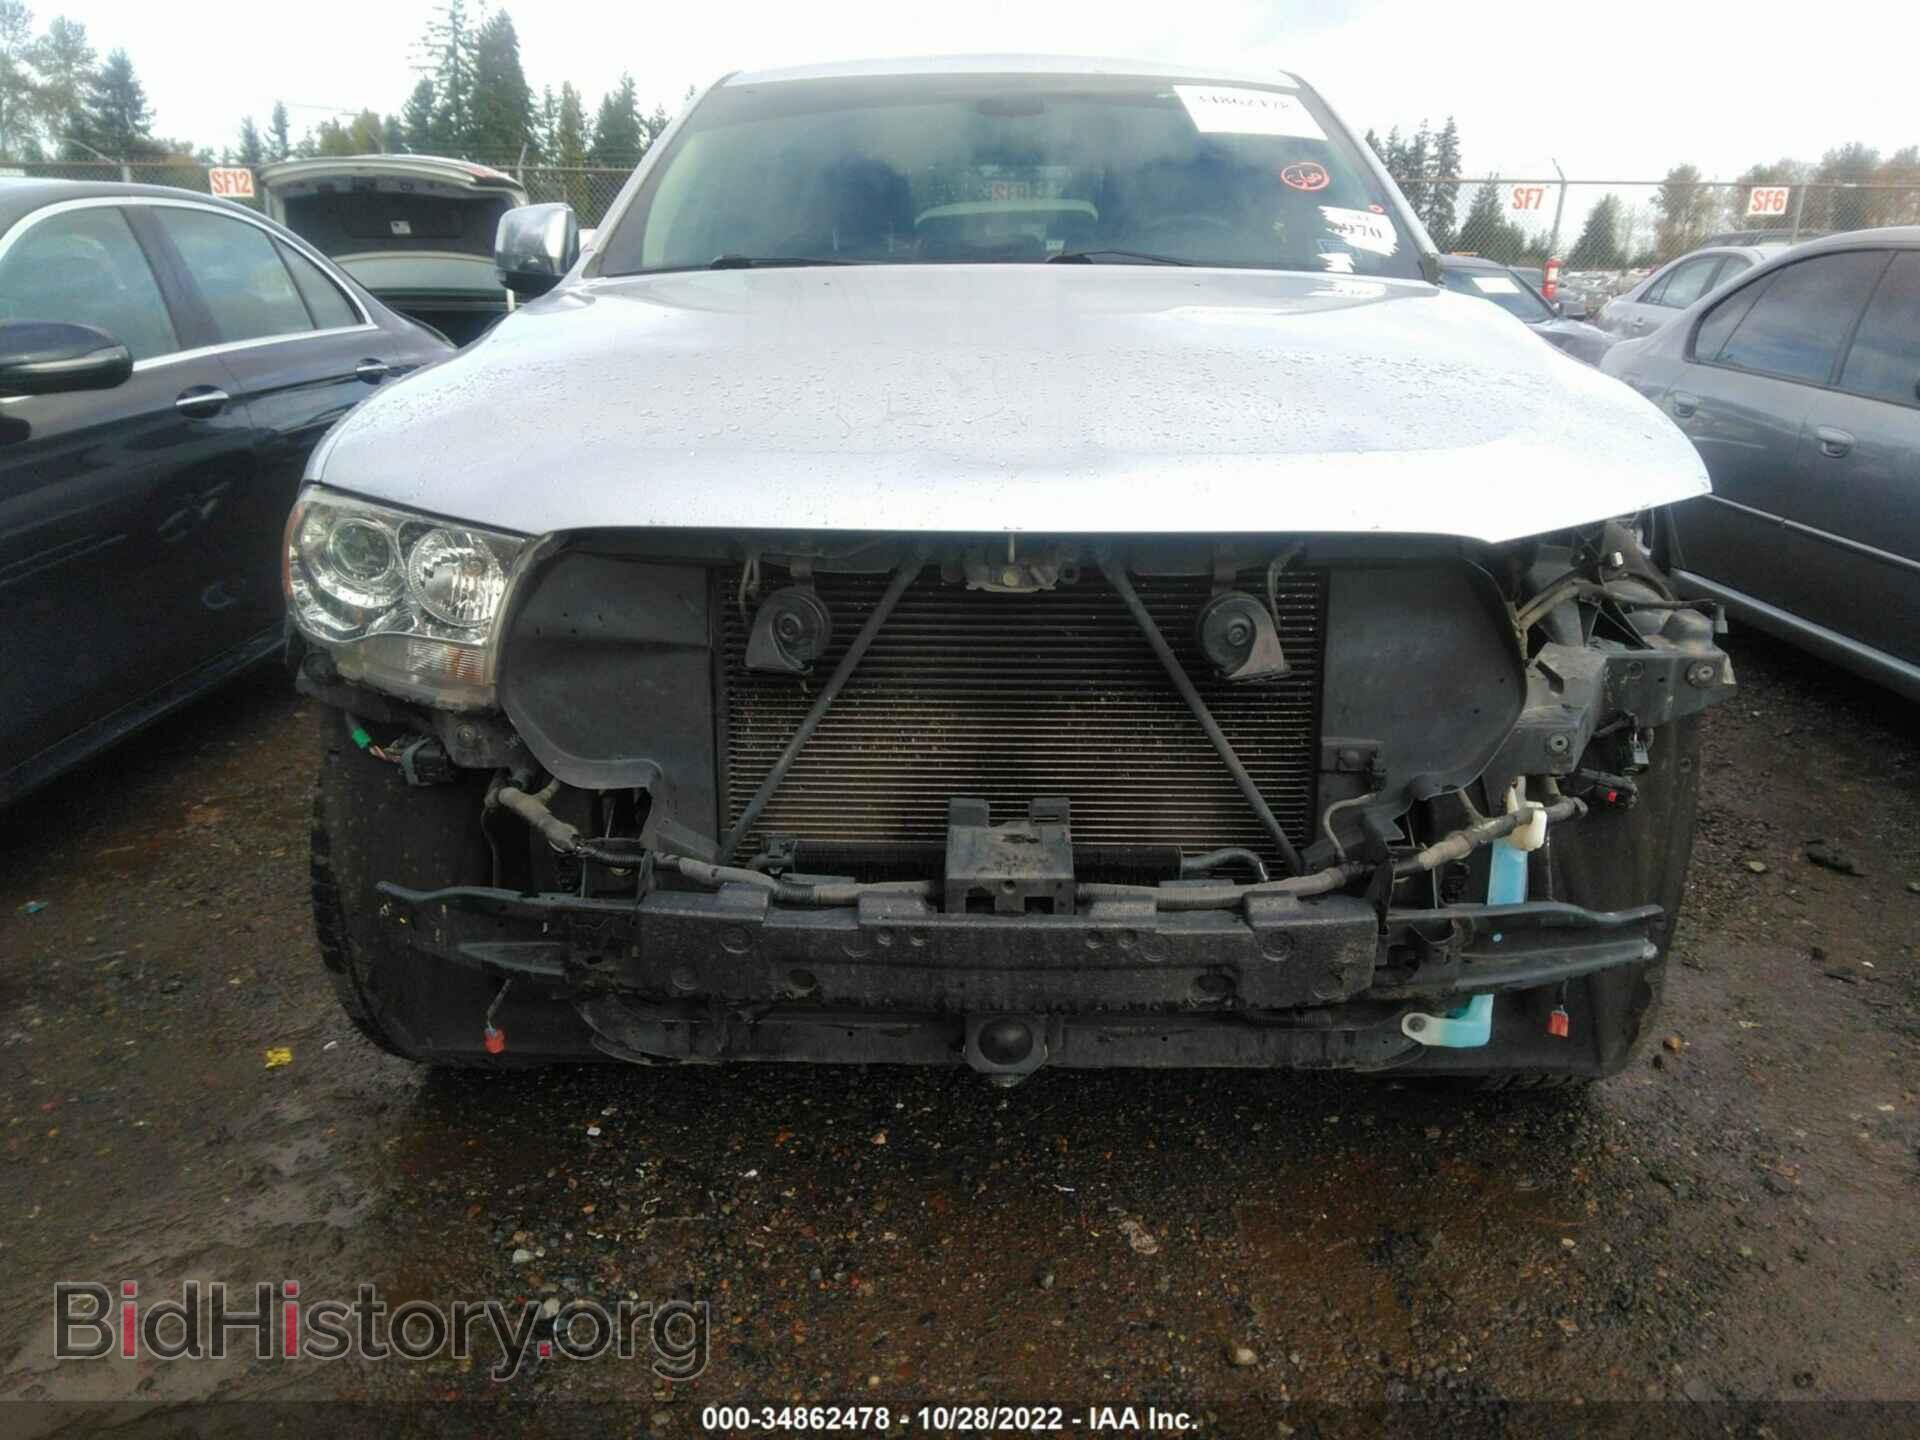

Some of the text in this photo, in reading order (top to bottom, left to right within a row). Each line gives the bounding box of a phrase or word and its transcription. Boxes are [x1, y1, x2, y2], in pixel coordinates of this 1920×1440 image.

[211, 171, 251, 193] SF12
[1512, 187, 1544, 209] SF7
[1751, 190, 1785, 211] SF6
